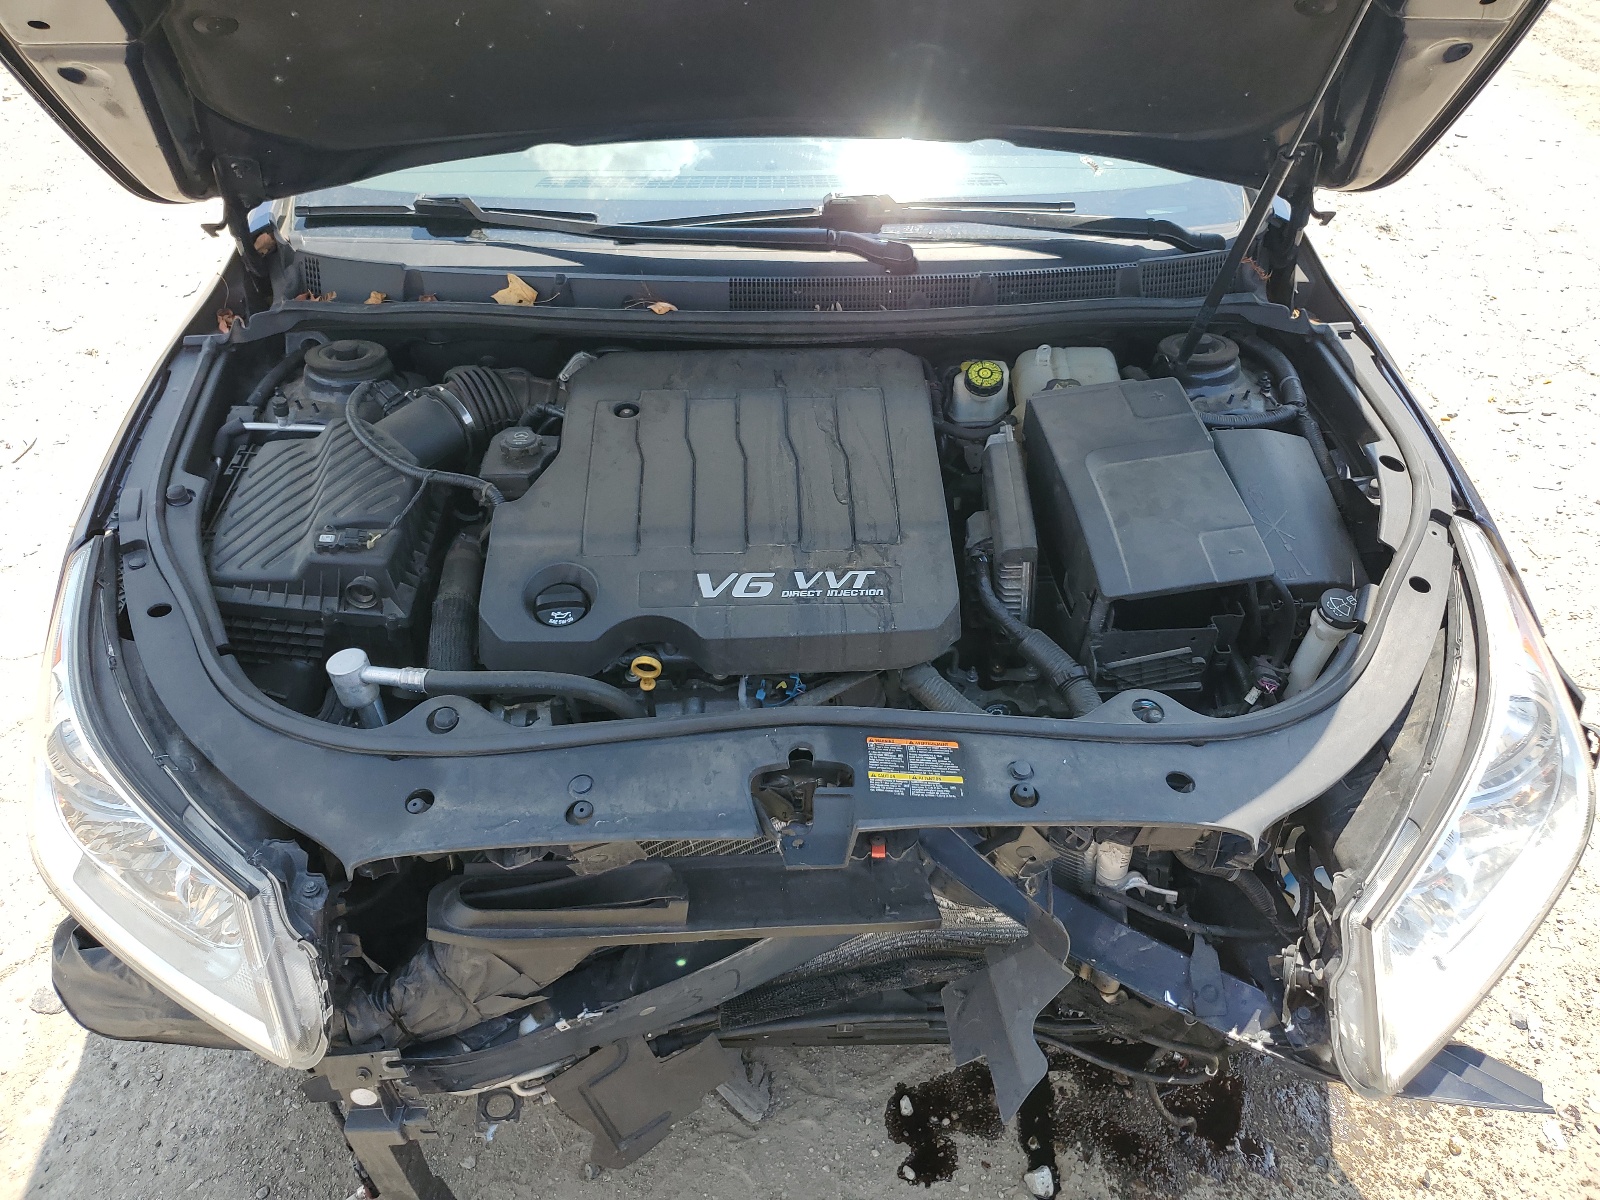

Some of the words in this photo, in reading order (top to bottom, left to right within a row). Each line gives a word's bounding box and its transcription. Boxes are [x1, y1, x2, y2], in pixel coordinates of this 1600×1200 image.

[696, 572, 776, 598] V6
[794, 570, 877, 590] VVT
[780, 589, 824, 599] DIRECT
[826, 588, 885, 598] INJECTION
